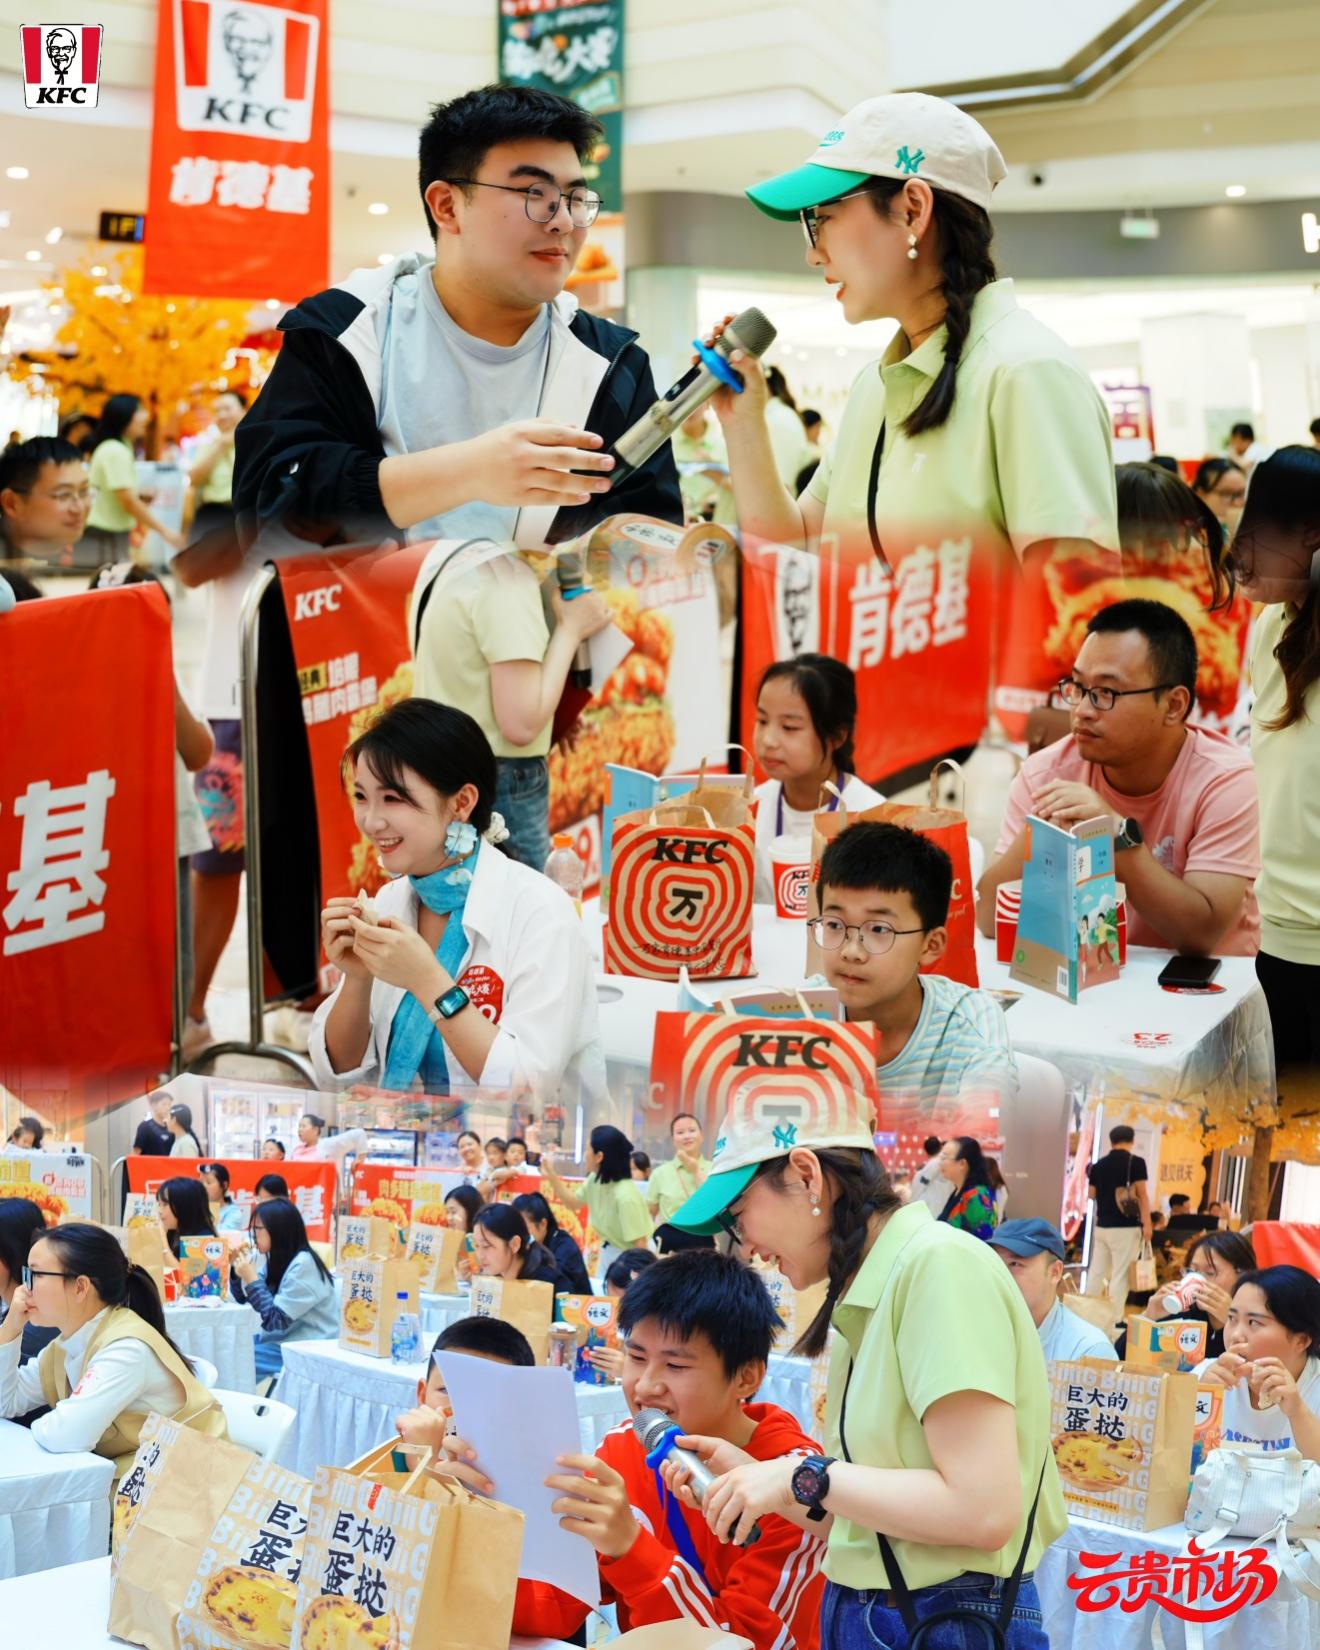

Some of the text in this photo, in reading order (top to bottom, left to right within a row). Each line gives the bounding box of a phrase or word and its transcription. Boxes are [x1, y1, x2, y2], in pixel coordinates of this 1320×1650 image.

[203, 97, 289, 131] KFC
[895, 145, 925, 174] NY
[169, 156, 313, 214] 肯德基
[294, 584, 342, 622] KFC
[848, 535, 972, 671] 肯德基
[2, 768, 116, 956] 基
[652, 838, 728, 864] KFC
[791, 871, 809, 880] KF
[670, 888, 704, 921] 万
[732, 1034, 832, 1070] KFC
[772, 1122, 798, 1149] NY
[350, 1283, 373, 1303] 蛋挞
[351, 1270, 374, 1283] 巨大的
[588, 1307, 609, 1318] 语文
[1180, 1333, 1198, 1344] 语文
[1067, 1385, 1129, 1412] 巨大的
[1063, 1406, 1126, 1442] 蛋挞
[332, 1509, 396, 1562] 巨大的
[320, 1548, 388, 1619] 蛋挞
